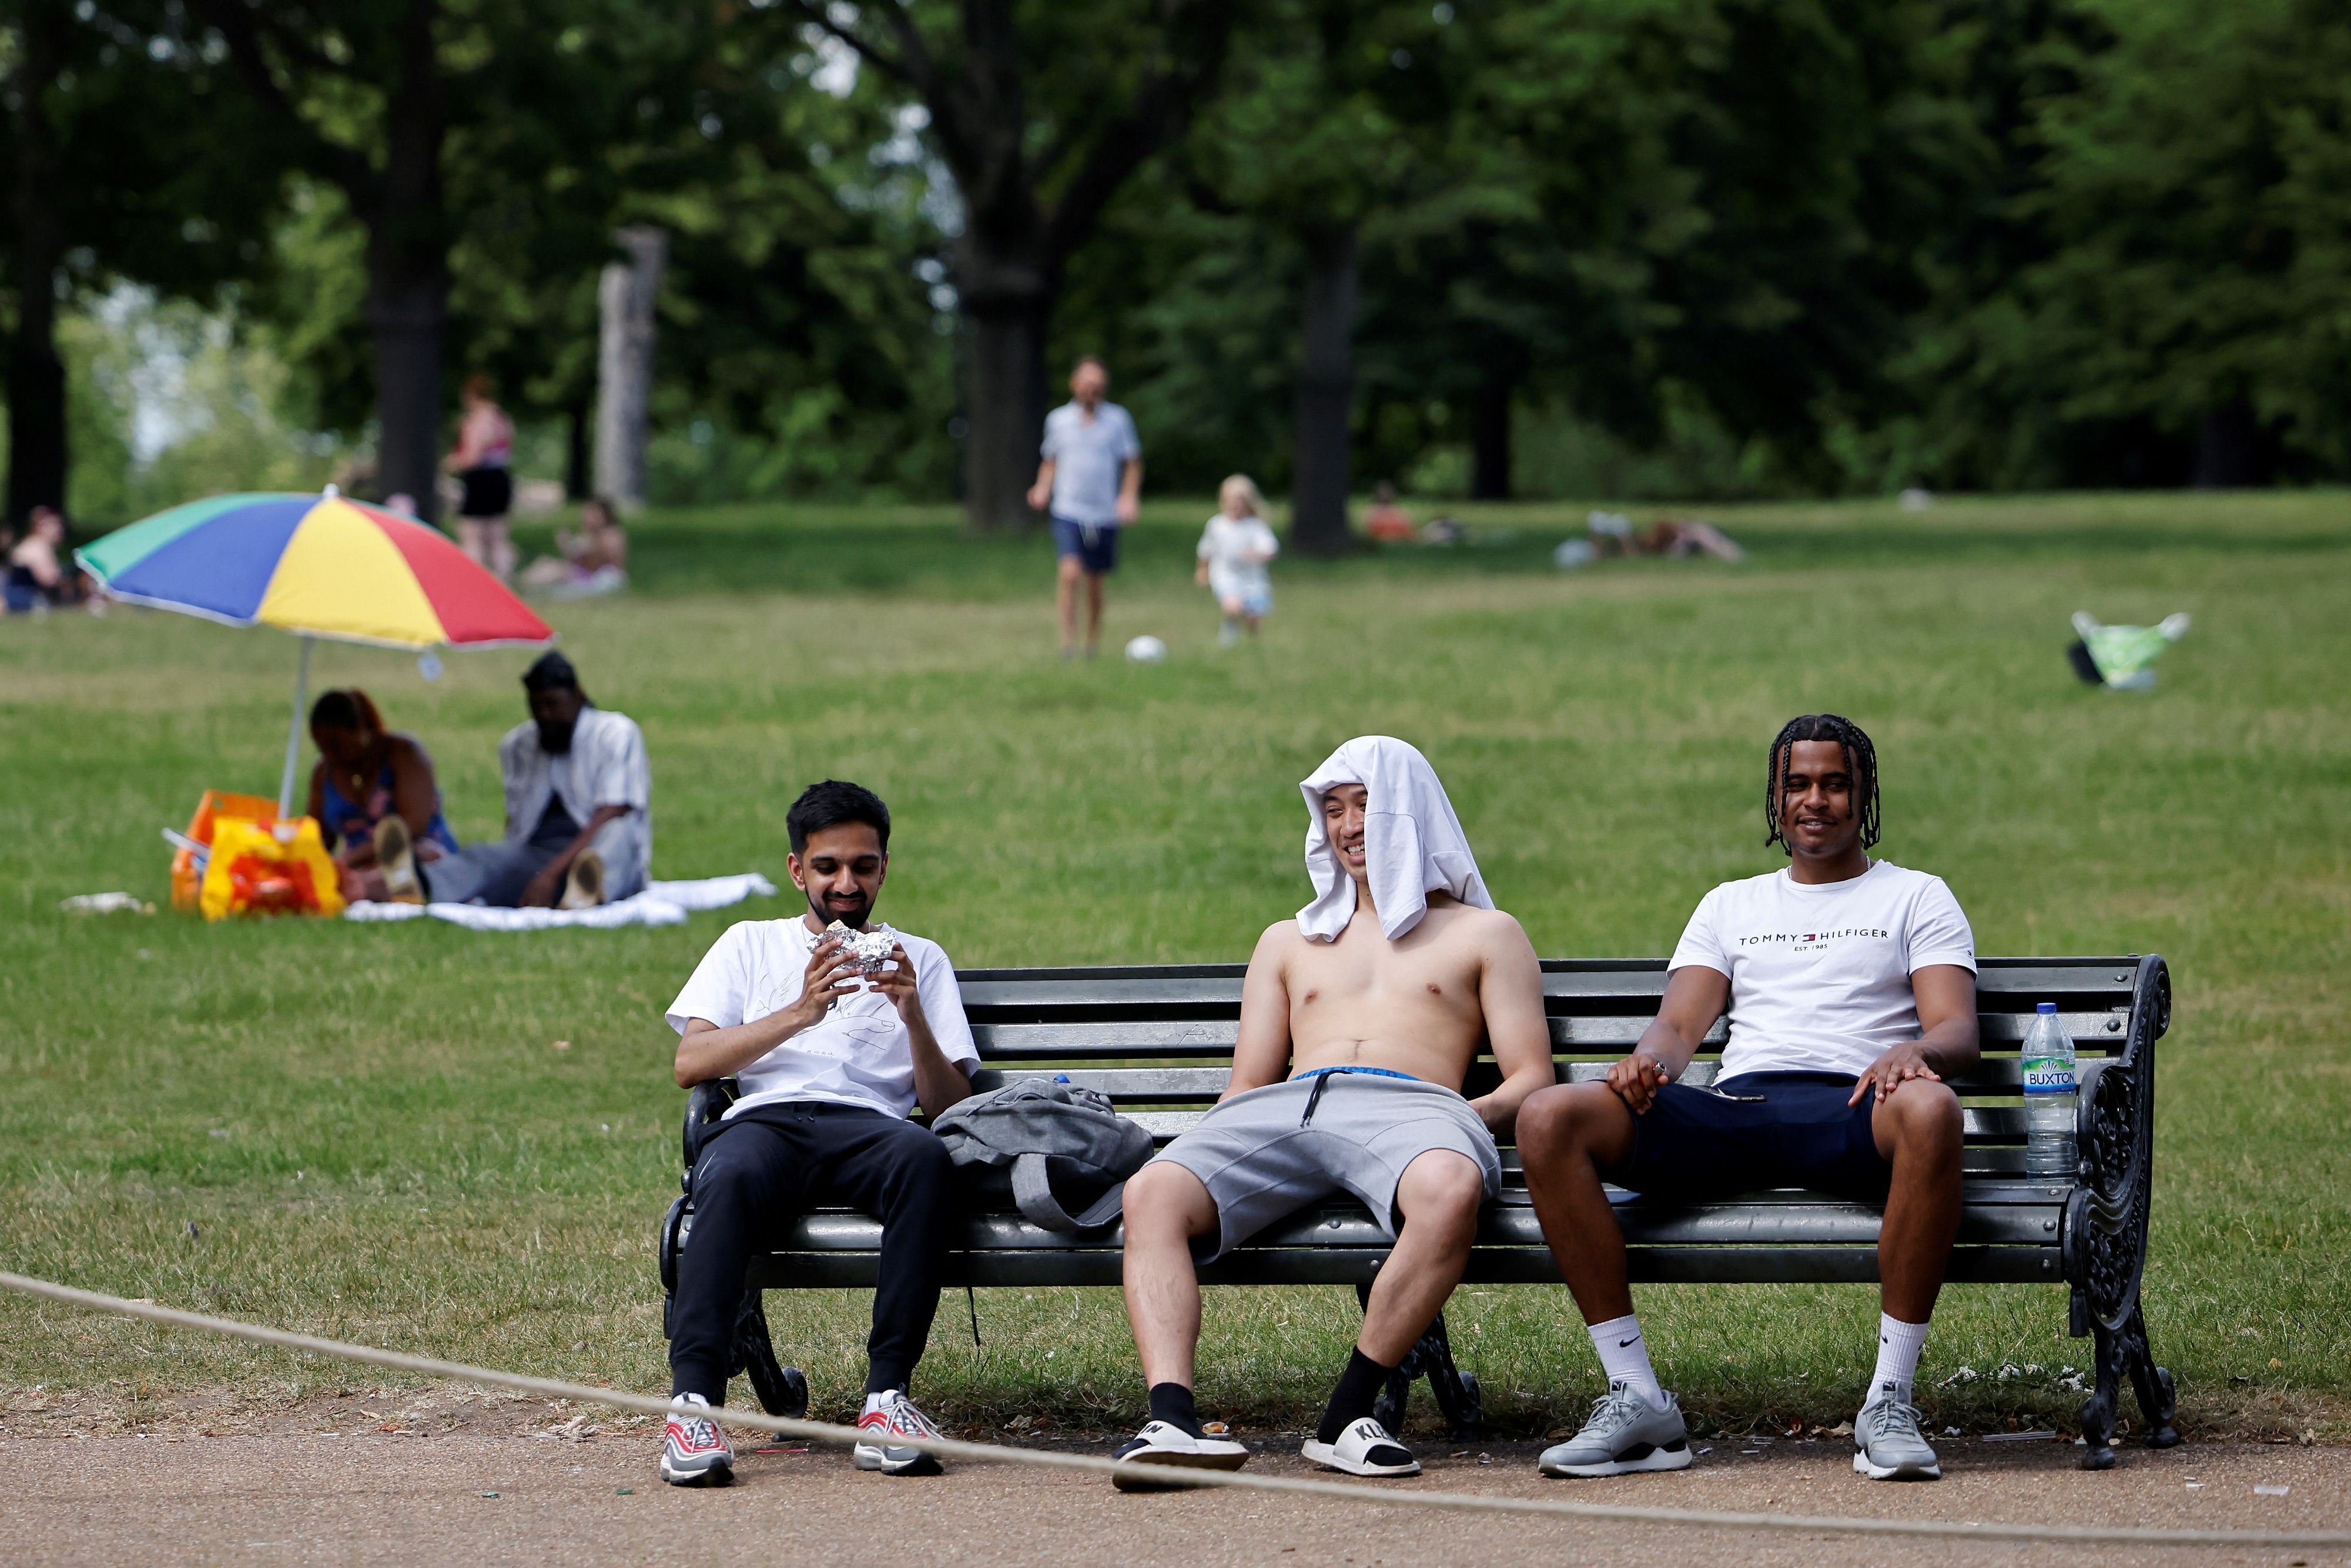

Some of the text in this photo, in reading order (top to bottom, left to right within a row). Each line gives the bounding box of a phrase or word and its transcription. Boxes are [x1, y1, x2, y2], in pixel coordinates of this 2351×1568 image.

[1739, 929, 1888, 946] TOMMY HILFIGER
[2030, 1071, 2074, 1085] BUXTON
